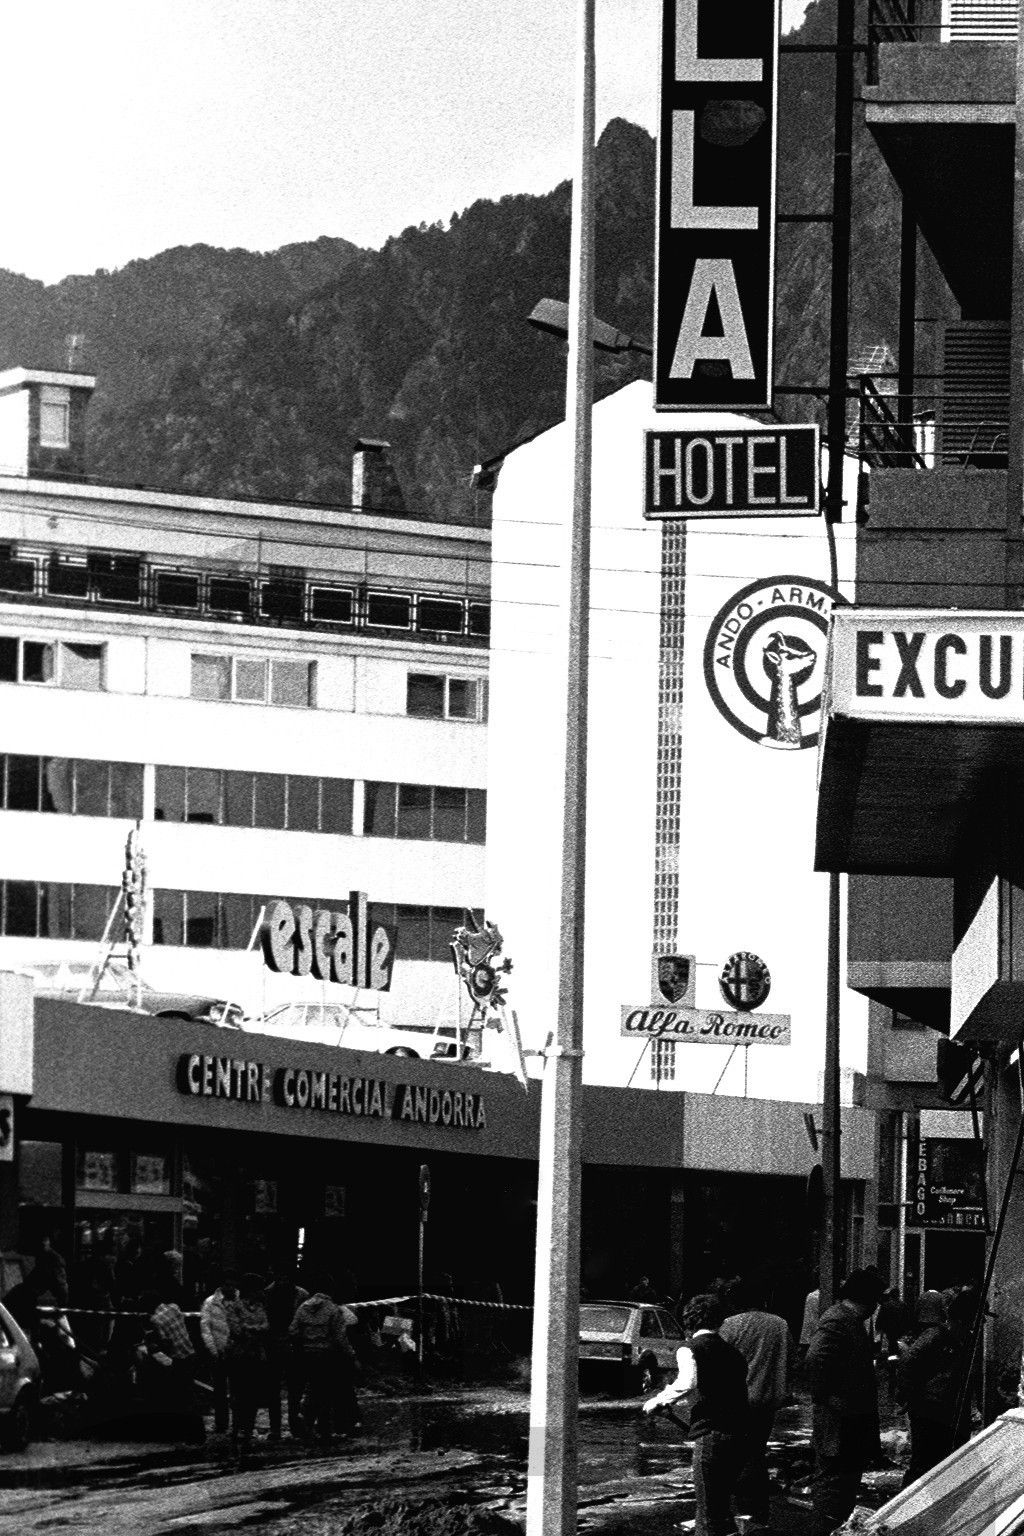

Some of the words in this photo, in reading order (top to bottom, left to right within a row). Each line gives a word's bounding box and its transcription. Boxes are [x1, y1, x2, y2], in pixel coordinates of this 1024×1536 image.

[652, 434, 809, 507] HOTEL
[262, 889, 394, 991] escale
[700, 1012, 787, 1040] Romeo
[184, 1053, 271, 1101] CENTRE
[280, 1068, 395, 1118] COMERCIAL
[400, 1085, 488, 1129] ANDORRA
[916, 1137, 928, 1216] EBAGO
